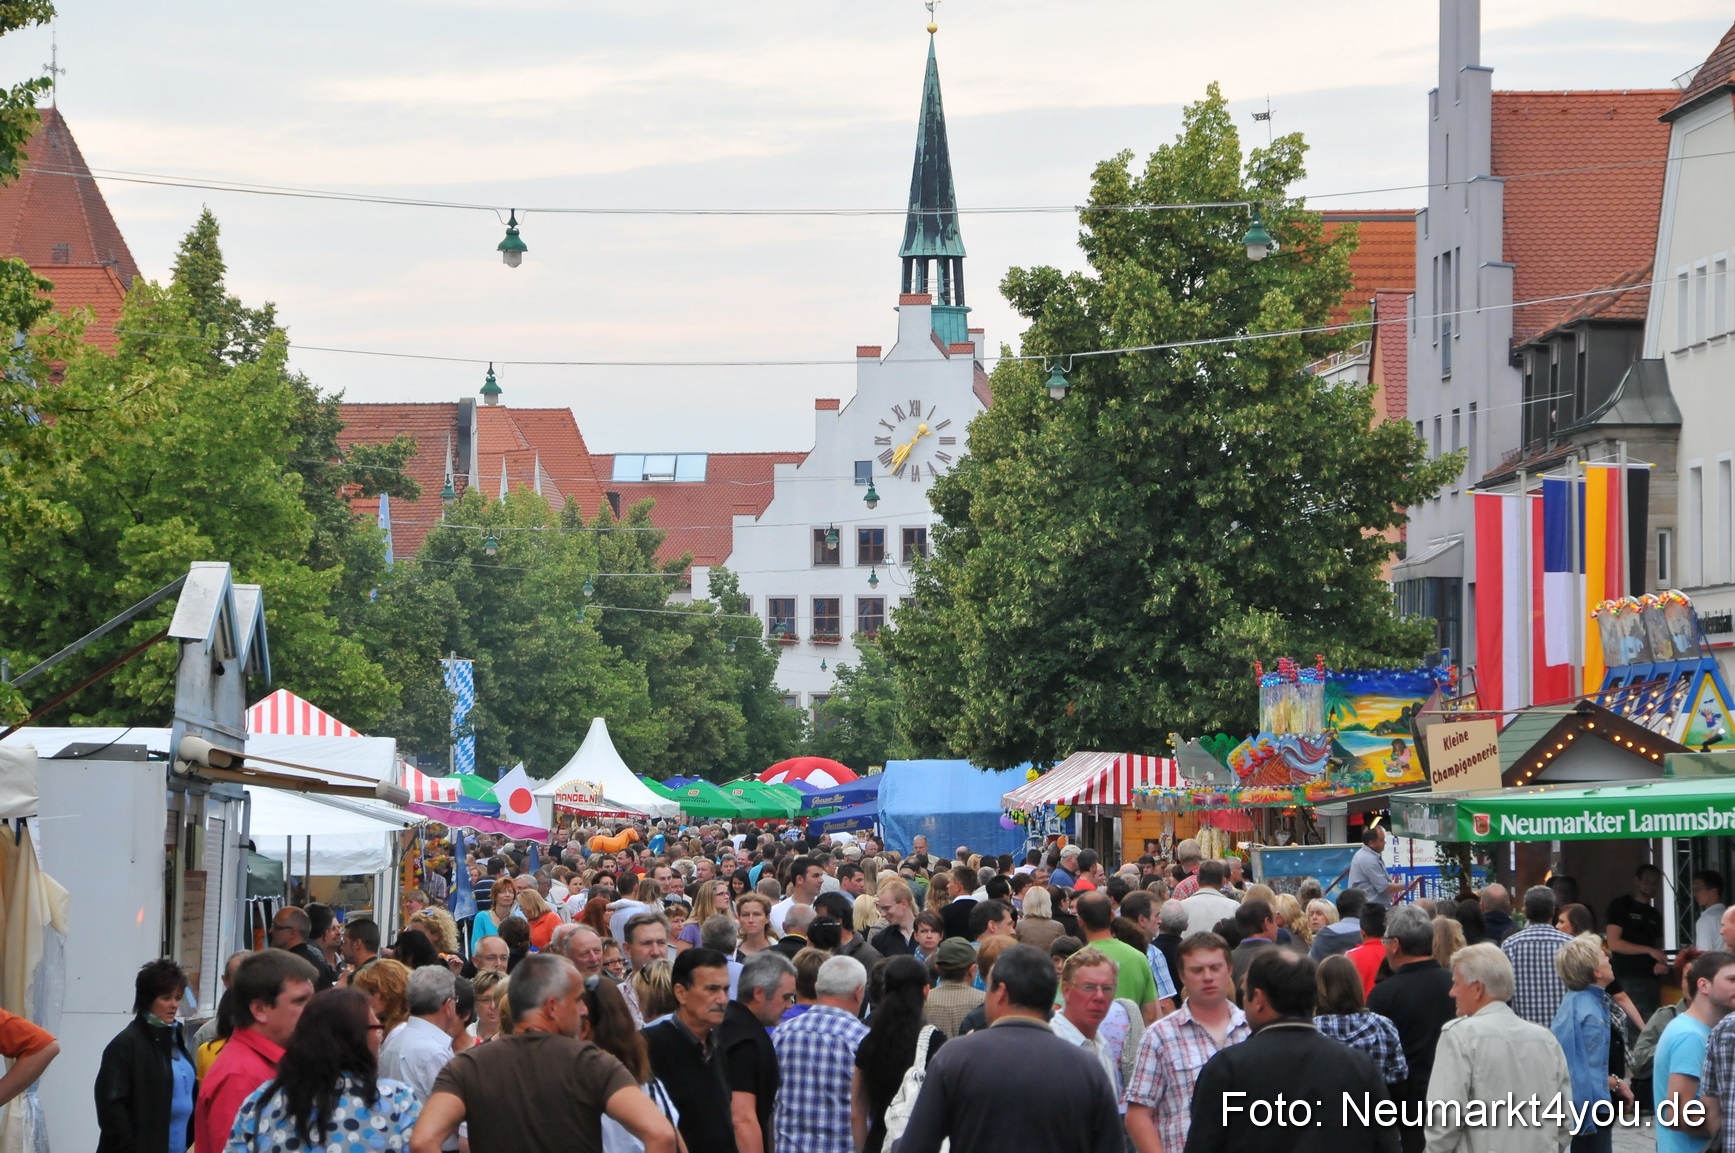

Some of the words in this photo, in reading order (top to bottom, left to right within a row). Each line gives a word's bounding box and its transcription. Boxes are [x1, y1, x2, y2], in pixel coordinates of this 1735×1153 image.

[909, 400, 920, 417] XII
[1442, 730, 1470, 751] Kleine
[1229, 737, 1276, 780] EIS
[1432, 743, 1498, 784] Champignonerie
[555, 793, 596, 803] MANDELN
[1500, 811, 1626, 836] Neumarkter
